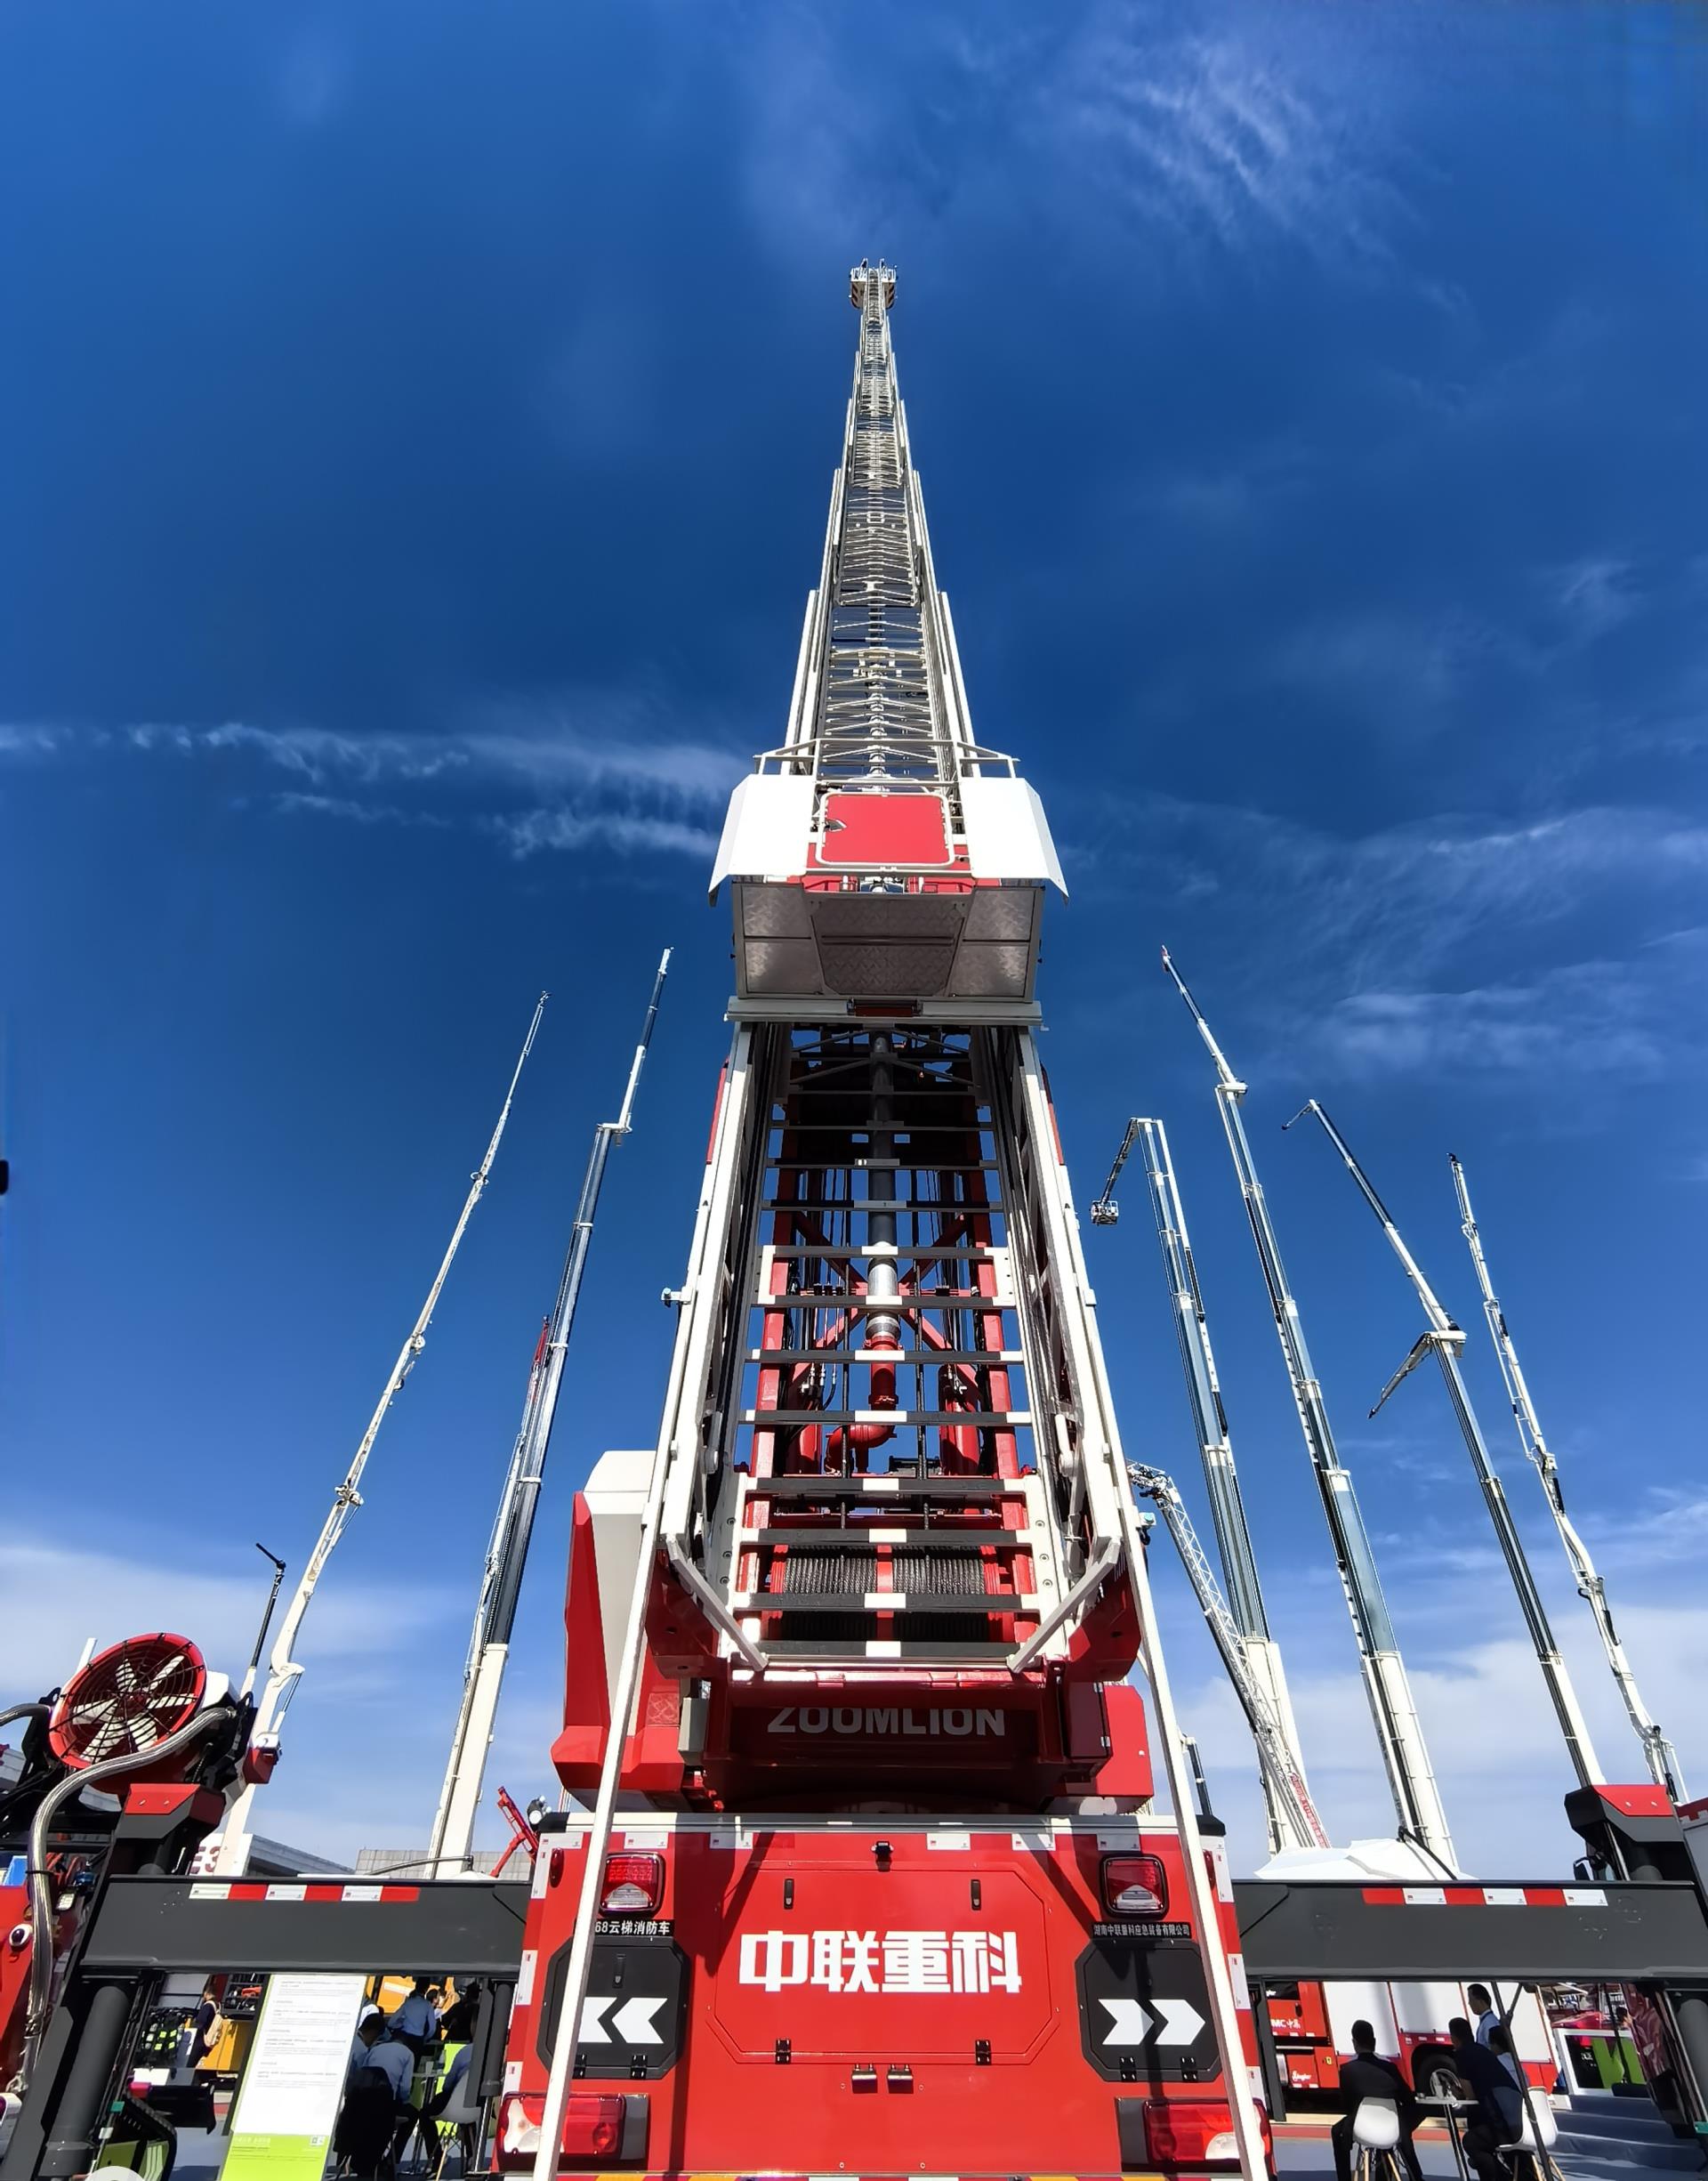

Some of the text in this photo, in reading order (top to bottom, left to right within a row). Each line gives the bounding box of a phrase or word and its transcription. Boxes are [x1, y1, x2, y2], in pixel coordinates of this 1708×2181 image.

[767, 1706, 1006, 1736] ZOOMLION
[738, 1930, 1023, 1993] 中联重科
